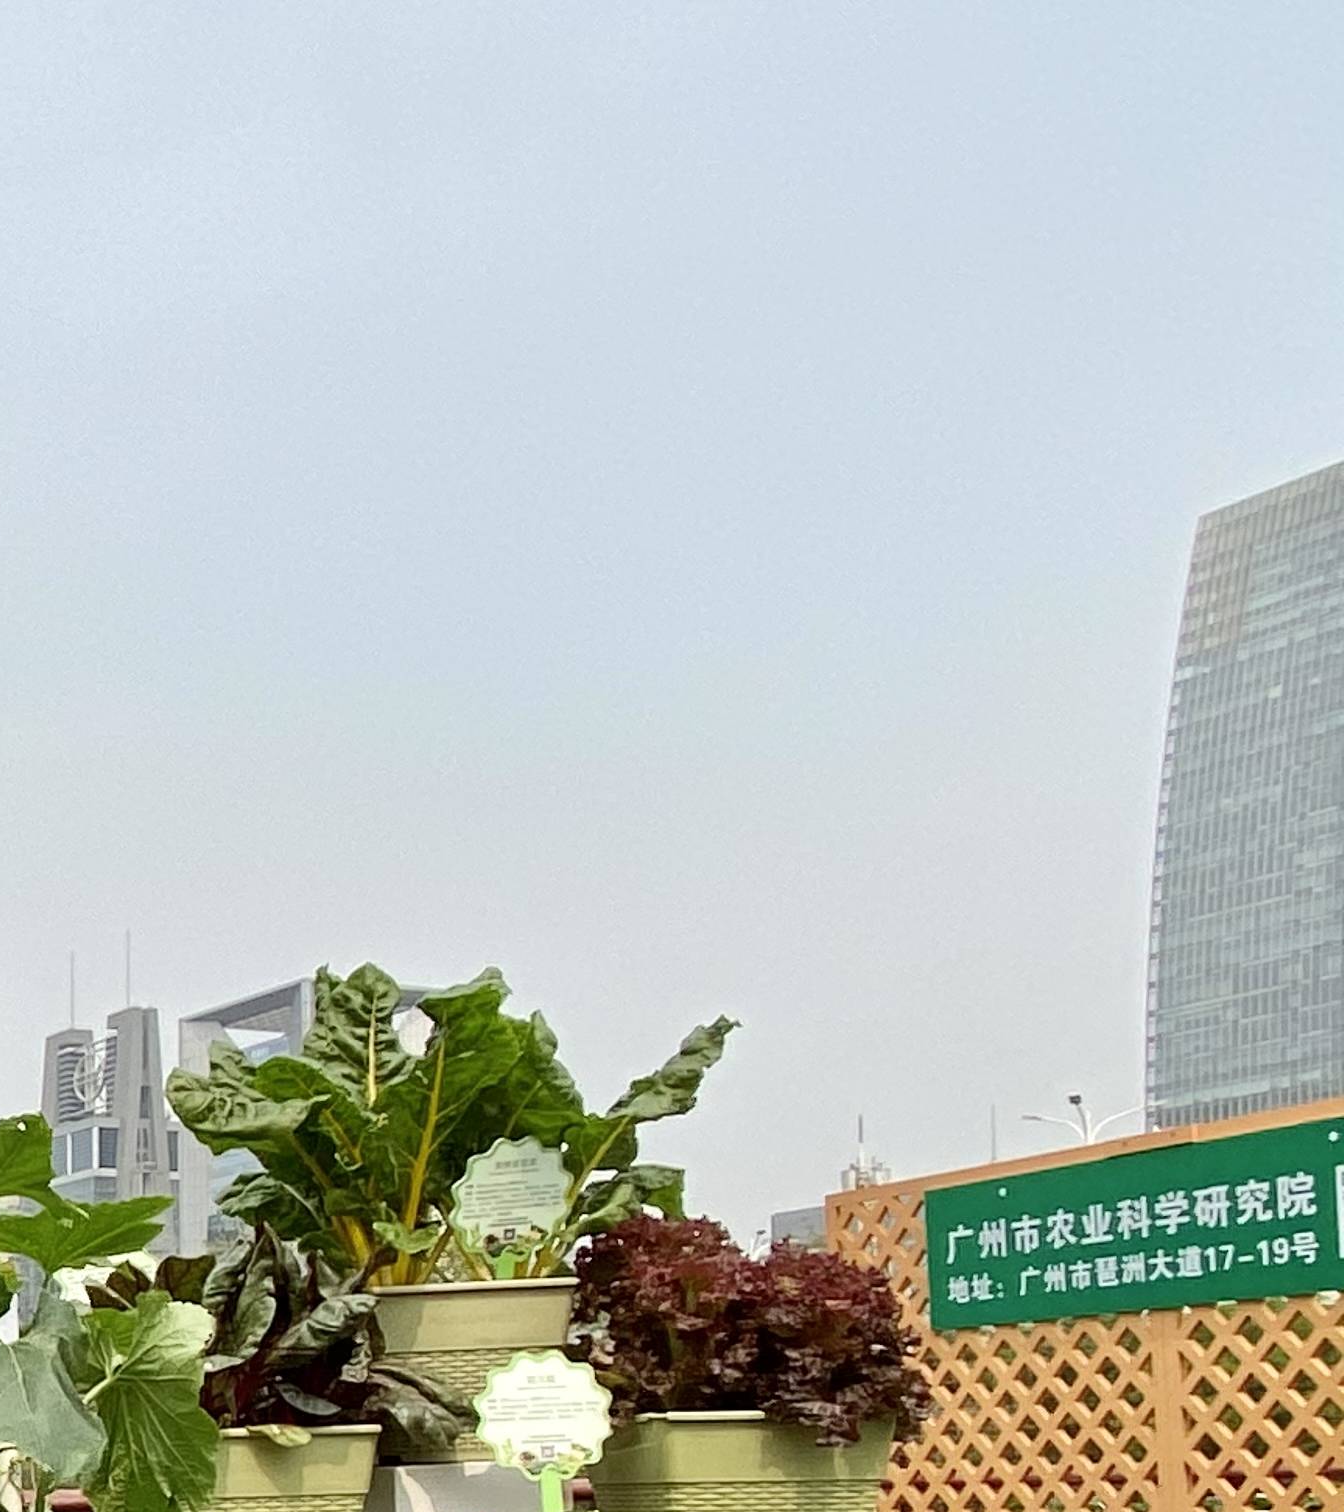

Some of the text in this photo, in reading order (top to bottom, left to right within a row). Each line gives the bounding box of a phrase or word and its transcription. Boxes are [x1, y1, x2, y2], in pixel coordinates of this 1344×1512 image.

[946, 1172, 1318, 1265] 广州市农业科学研究院
